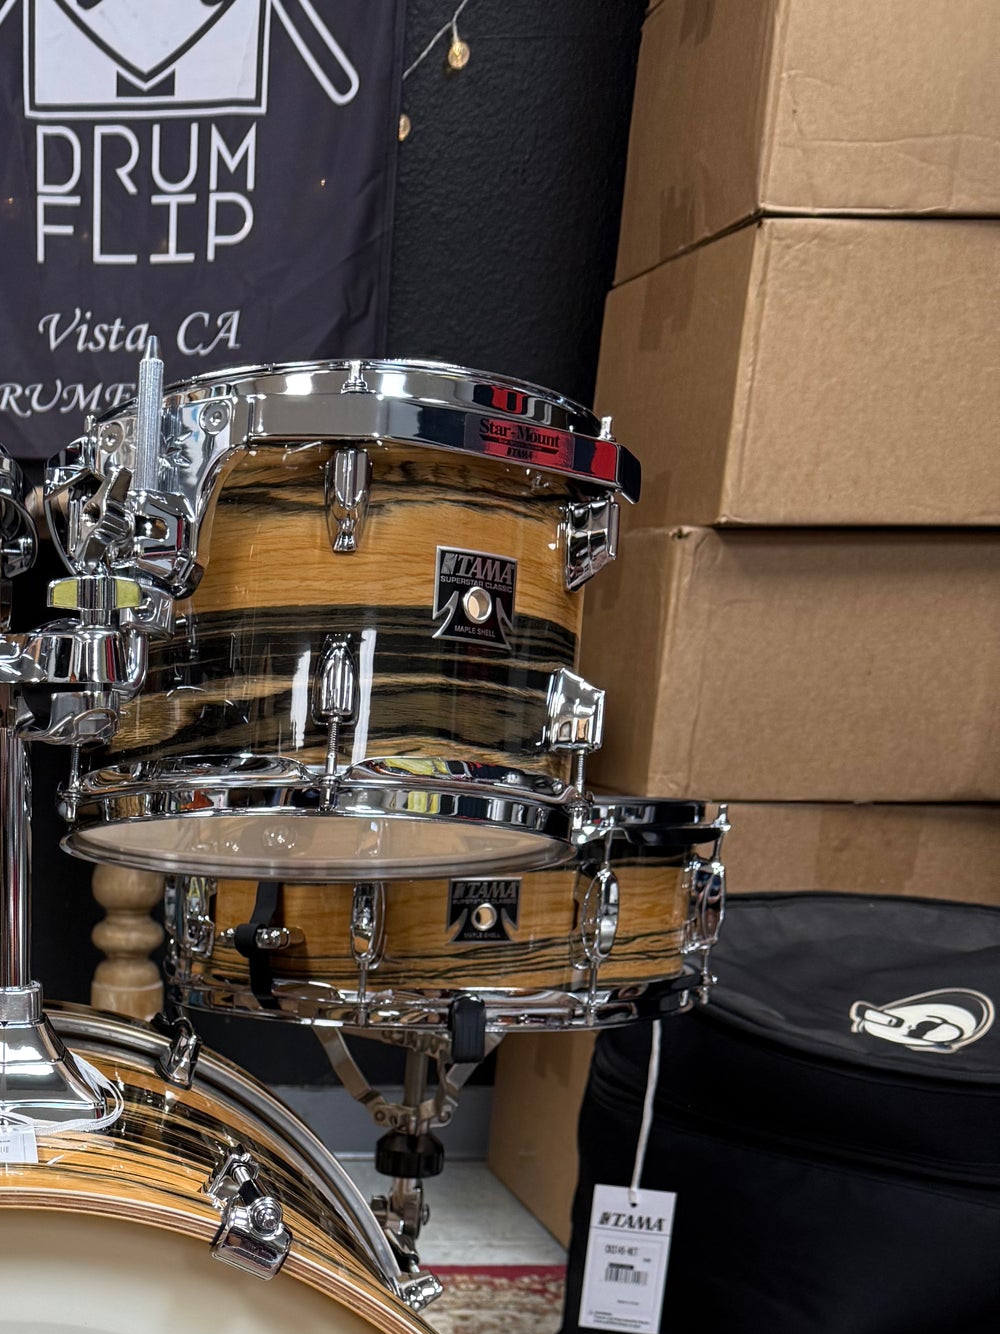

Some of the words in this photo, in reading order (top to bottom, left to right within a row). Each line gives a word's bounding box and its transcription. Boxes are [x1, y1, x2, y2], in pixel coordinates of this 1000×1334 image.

[36, 122, 257, 195] DRUM
[36, 192, 254, 264] FLIP
[37, 307, 150, 352] Vista
[176, 309, 242, 356] CA
[479, 417, 561, 448] Star-Mount
[440, 575, 484, 589] SUPERSTAR
[485, 582, 513, 594] CLASSIC
[456, 554, 514, 586] TAMA
[454, 624, 476, 635] MAPLE
[477, 628, 497, 638] SHELL
[464, 881, 519, 899] TAMA
[611, 1211, 665, 1232] TAMA
